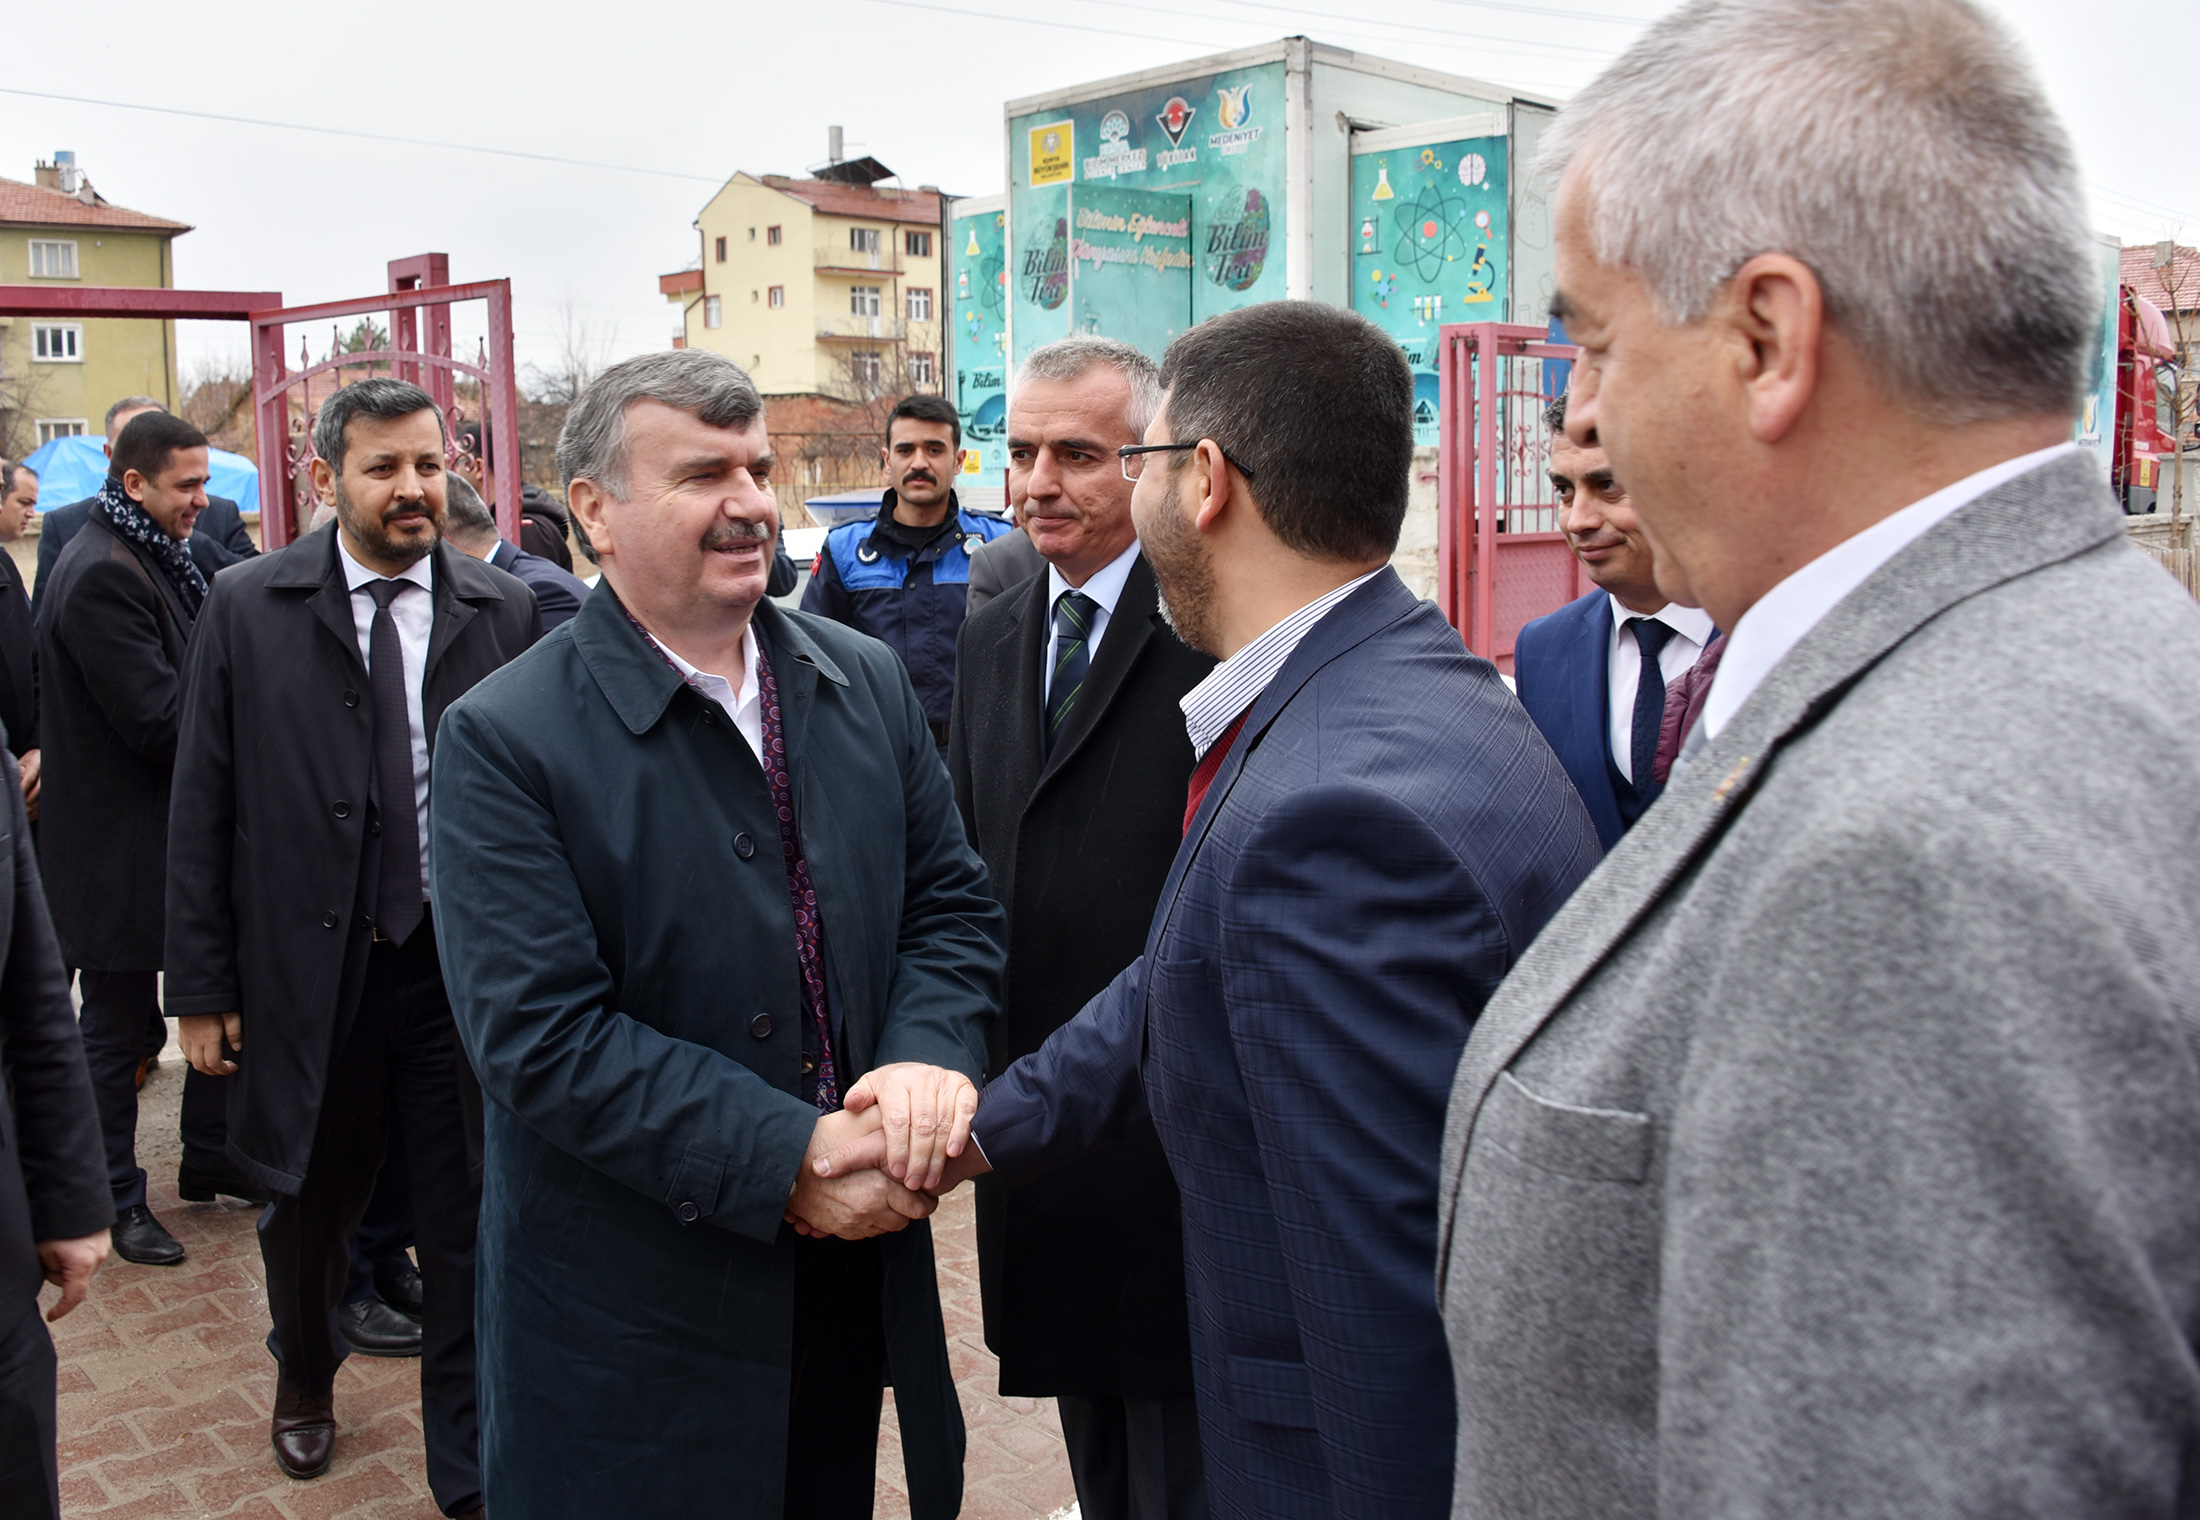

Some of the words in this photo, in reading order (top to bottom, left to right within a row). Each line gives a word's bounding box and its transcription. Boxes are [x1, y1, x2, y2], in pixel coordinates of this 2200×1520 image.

[1210, 129, 1259, 145] MEDENİYET
[1207, 222, 1266, 254] Bilim
[972, 371, 1001, 389] Bilim
